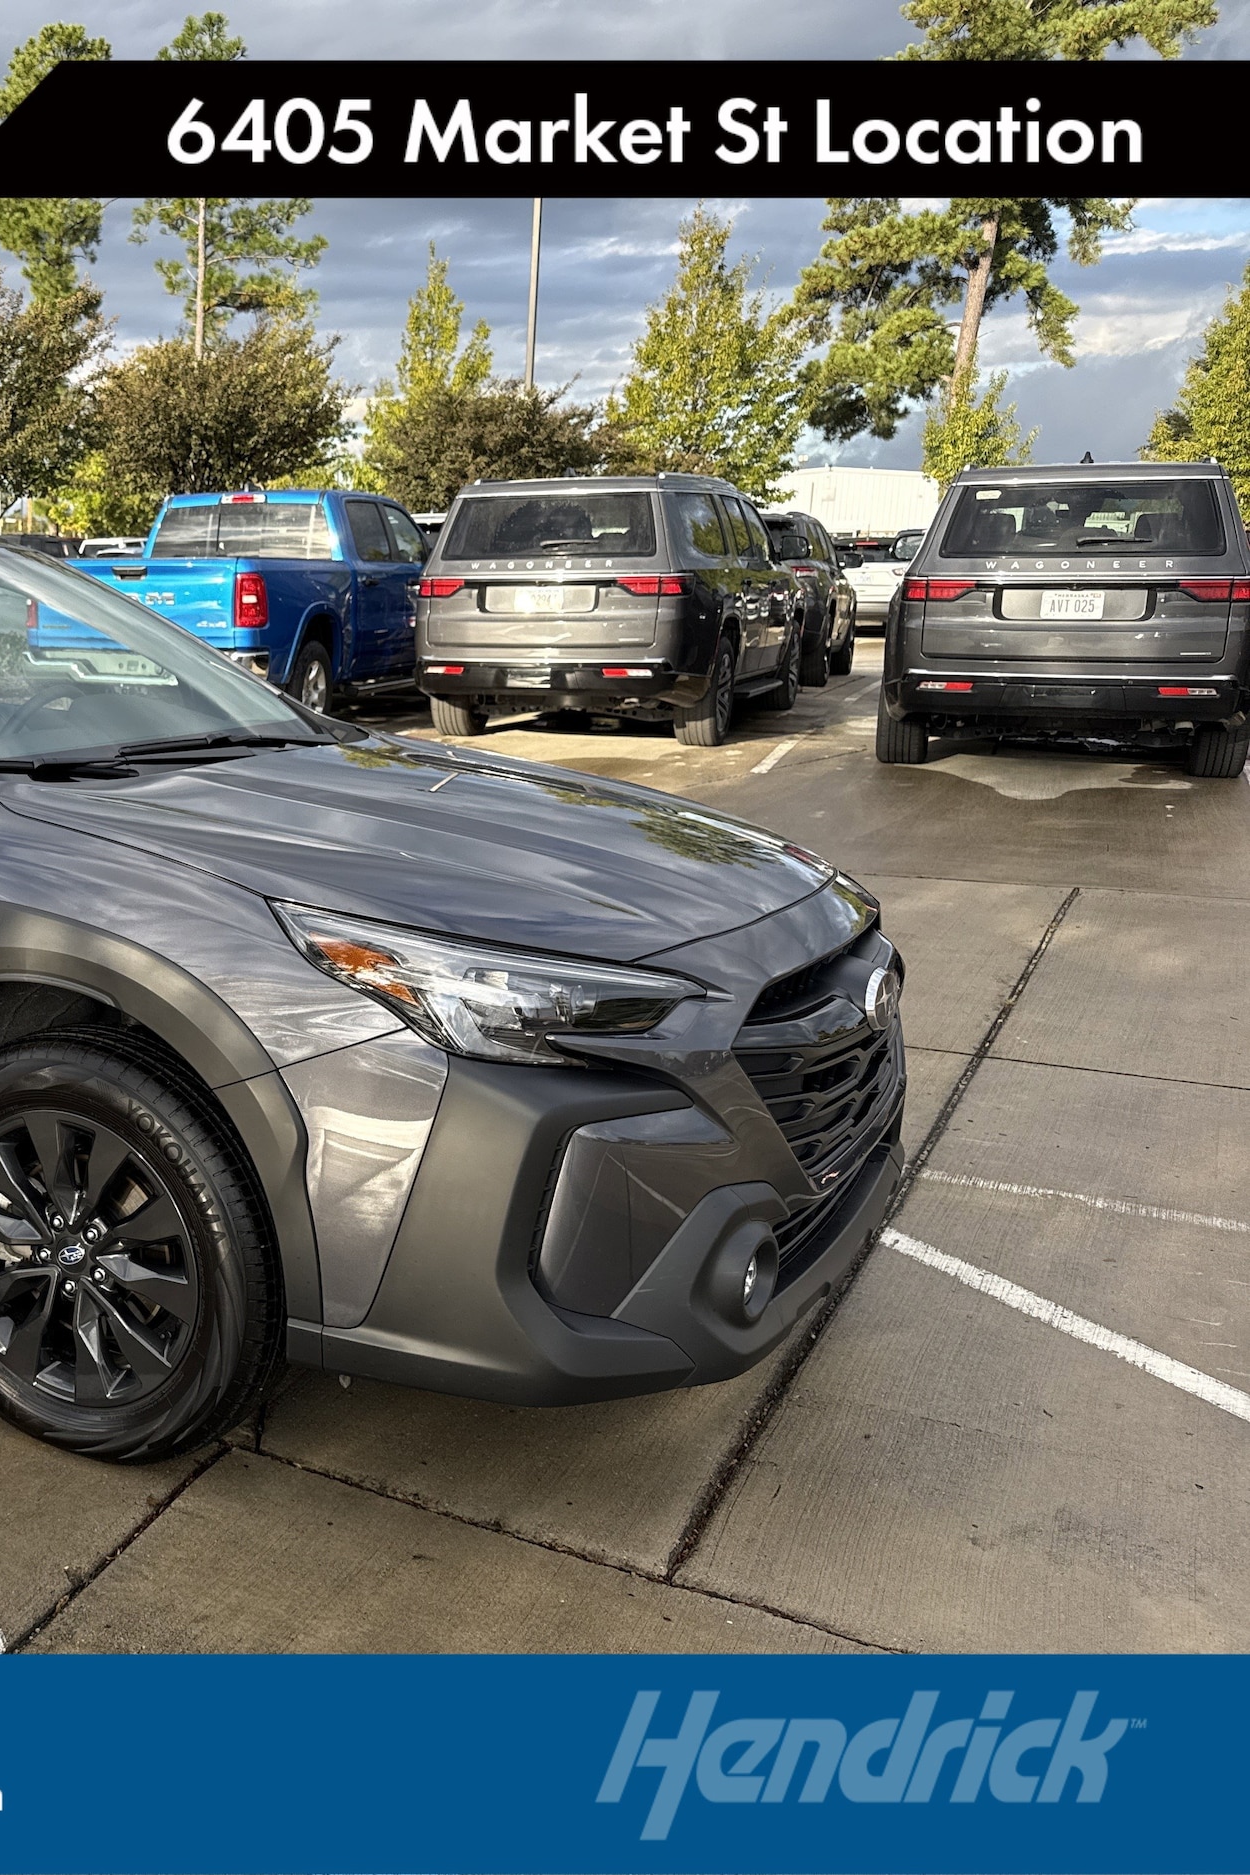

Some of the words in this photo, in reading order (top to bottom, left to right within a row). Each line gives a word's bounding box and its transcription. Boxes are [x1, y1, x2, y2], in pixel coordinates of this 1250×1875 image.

[471, 559, 613, 570] WAGONEER
[985, 559, 1175, 570] WAGONEER
[1050, 599, 1070, 613] AVT
[1074, 599, 1095, 613] 025
[126, 1099, 227, 1244] YOKOHAMA
